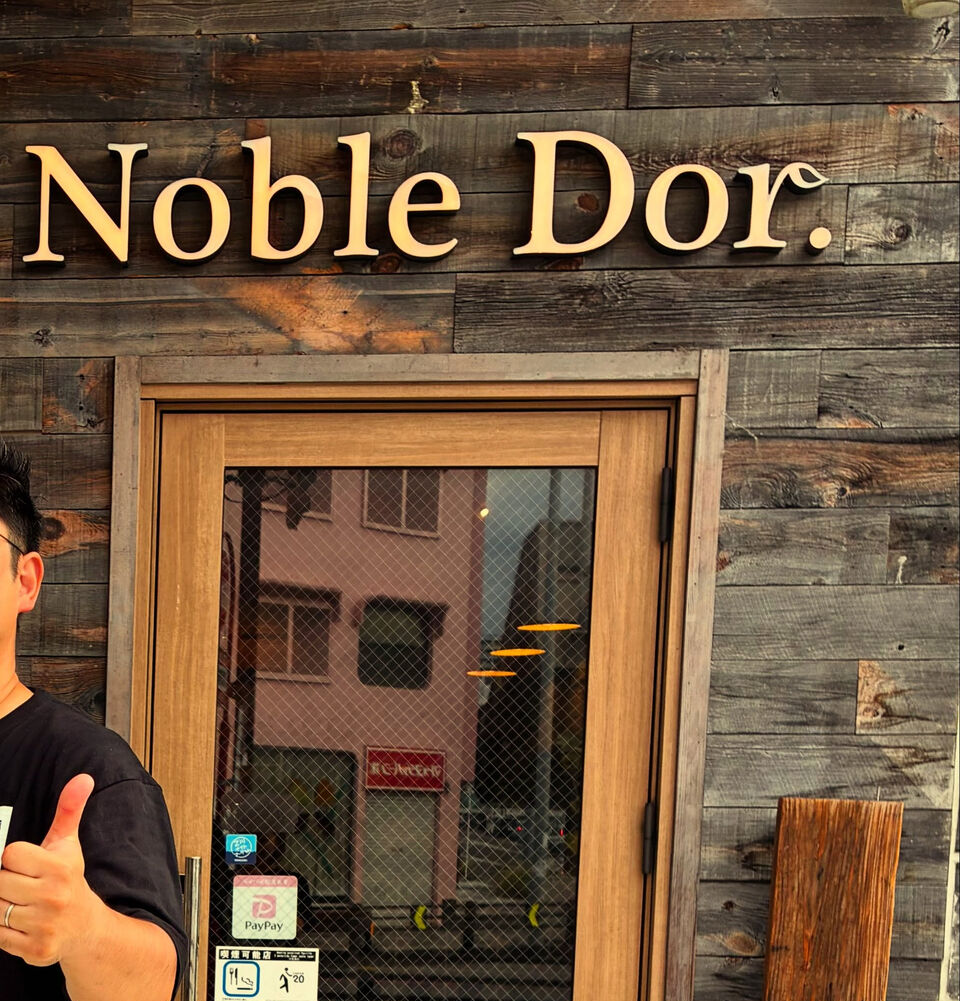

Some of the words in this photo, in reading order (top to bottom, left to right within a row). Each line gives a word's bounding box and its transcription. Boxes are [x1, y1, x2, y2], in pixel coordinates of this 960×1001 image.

[22, 131, 461, 263] Noble
[513, 130, 833, 256] Dor.
[245, 920, 283, 932] PayPay
[292, 974, 305, 984] 20
